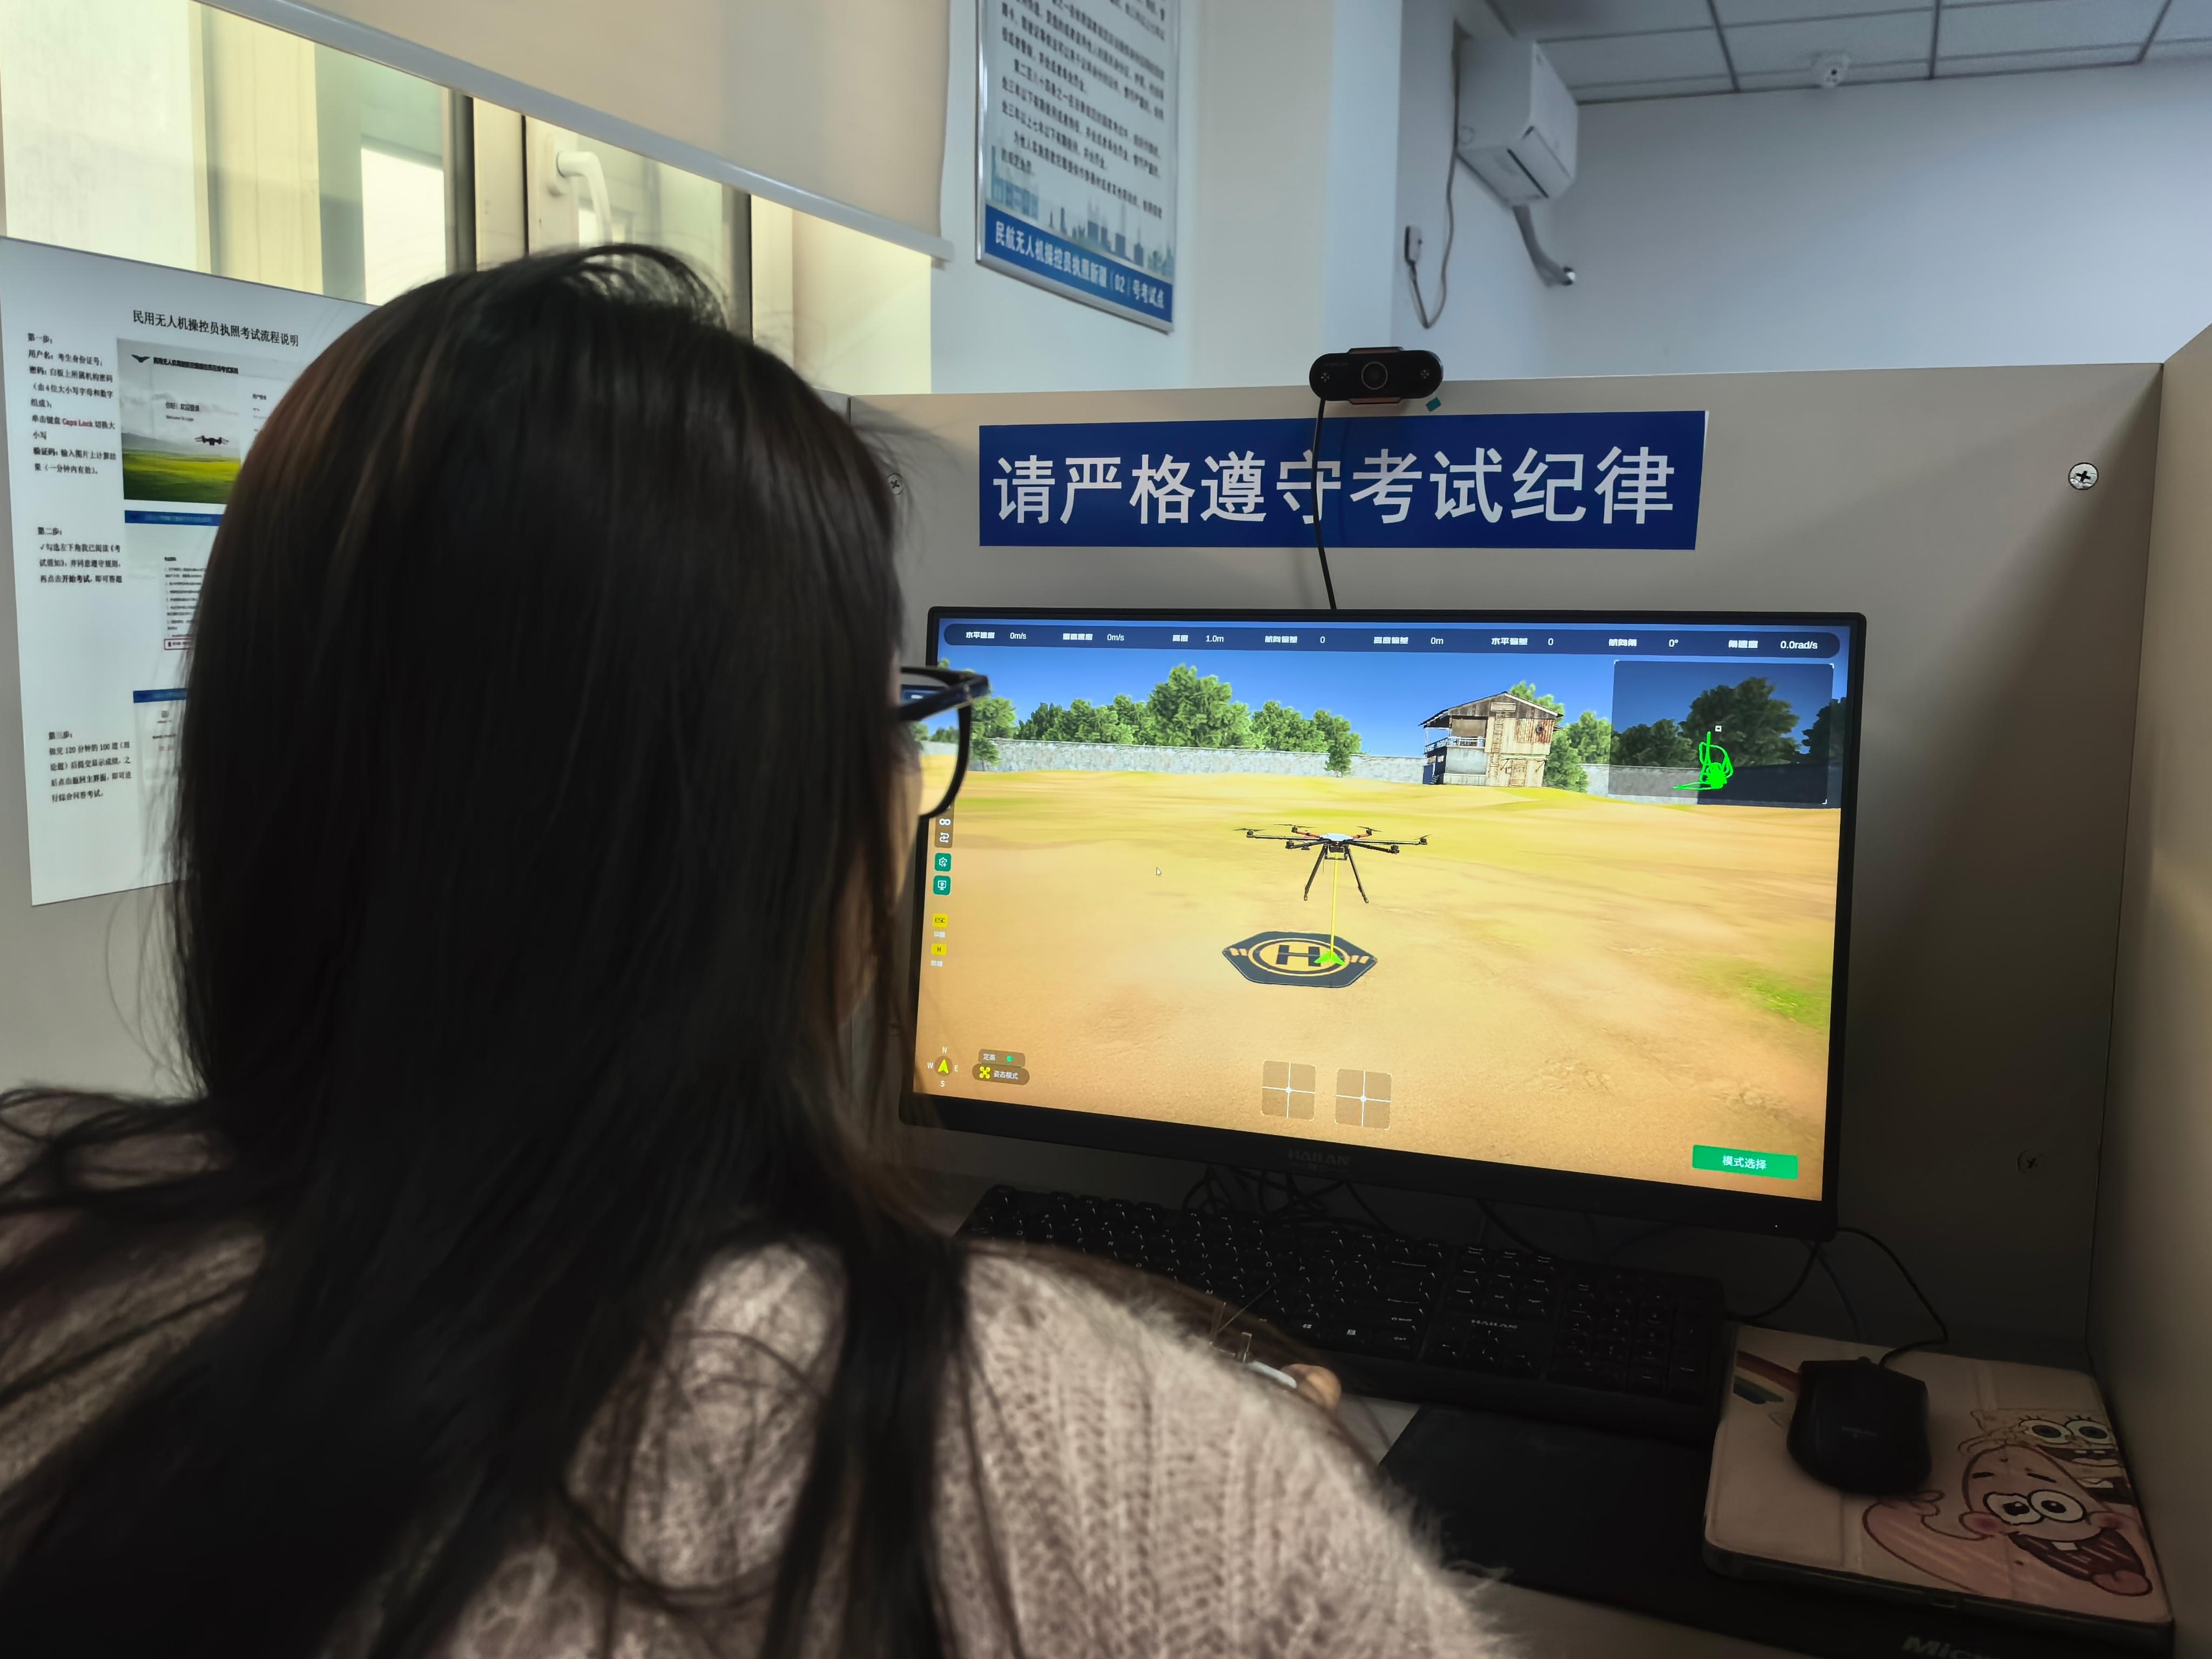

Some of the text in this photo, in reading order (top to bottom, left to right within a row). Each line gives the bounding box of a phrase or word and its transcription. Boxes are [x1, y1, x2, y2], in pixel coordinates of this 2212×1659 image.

[133, 309, 299, 347] 民用无人机操控员执照考试流程说明
[62, 418, 78, 427] Caps
[78, 419, 93, 428] Lock
[992, 446, 1676, 526] 请严格遵守考试纪律
[1205, 635, 1224, 643] 1.0m
[1547, 638, 1554, 646] 0
[1780, 640, 1818, 649] 0.0rad/s
[65, 746, 76, 754] 120
[100, 743, 110, 751] 100
[1276, 944, 1321, 967] H
[1722, 1154, 1768, 1171] 模式选择
